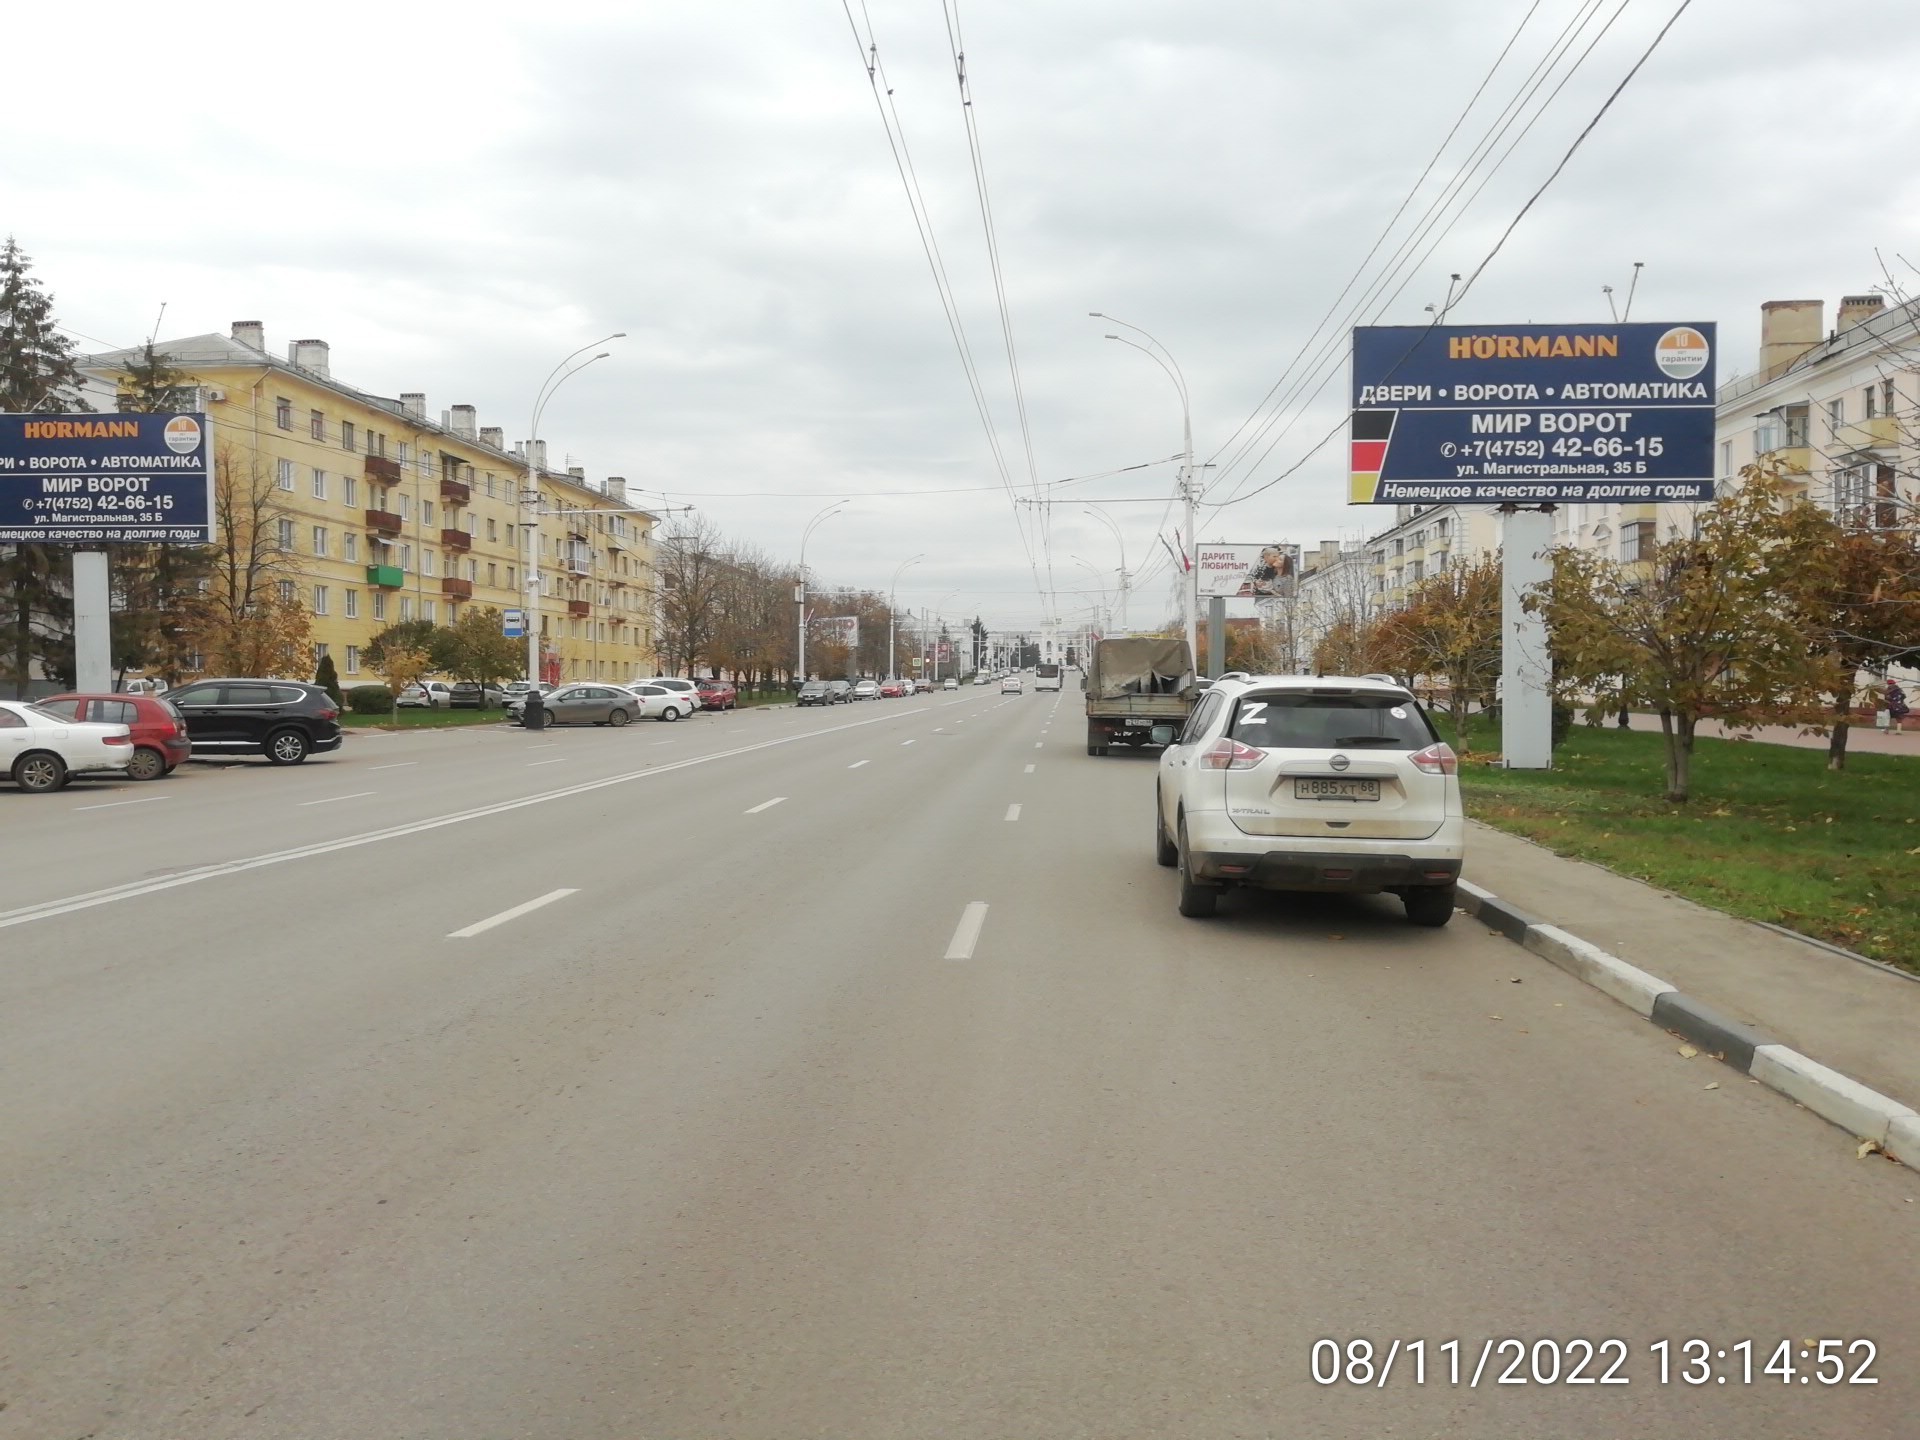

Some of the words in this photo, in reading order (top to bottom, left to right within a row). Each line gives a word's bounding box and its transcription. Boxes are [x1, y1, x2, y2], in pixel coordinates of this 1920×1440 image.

[1450, 334, 1618, 359] HÖRMANN
[1675, 333, 1689, 347] 10
[1360, 385, 1431, 404] ДВЕРИ
[1455, 384, 1539, 400] ВОРОТА
[1561, 382, 1708, 399] АВТОМАТИКА
[25, 421, 138, 438] HÖRMANN
[1472, 413, 1532, 434] МИР
[1540, 412, 1632, 433] ВОРОТ
[1461, 440, 1545, 459] +7(4752)
[1552, 437, 1664, 457] 42-66-15
[29, 457, 87, 468] ВОРОТА
[101, 456, 202, 468] АВТОМАТИКА
[1457, 465, 1479, 477] ул.
[1484, 462, 1609, 476] Магистральная,
[1613, 461, 1632, 474] 35
[1636, 461, 1647, 474] Б
[42, 478, 82, 492] МИР
[87, 477, 150, 492] ВОРОТ
[1383, 484, 1472, 499] Немецкое
[1476, 486, 1557, 498] качество
[1562, 486, 1583, 497] на
[1587, 485, 1652, 499] долгие
[1655, 485, 1700, 498] годы
[36, 497, 92, 511] +7(4752)
[97, 495, 174, 509] 42-66-15
[34, 515, 49, 524] ул.
[52, 513, 137, 523] Магистральная,
[140, 512, 152, 522] 35
[155, 512, 163, 521] Б
[0, 530, 45, 540] мецкое
[49, 530, 103, 539] качество
[106, 530, 121, 538] на
[123, 529, 166, 540] долгие
[169, 529, 200, 540] годы
[1201, 553, 1235, 561] ДАРИТЕ
[1201, 562, 1249, 570] ЛЮБИМЫМ
[1240, 702, 1268, 725] Z
